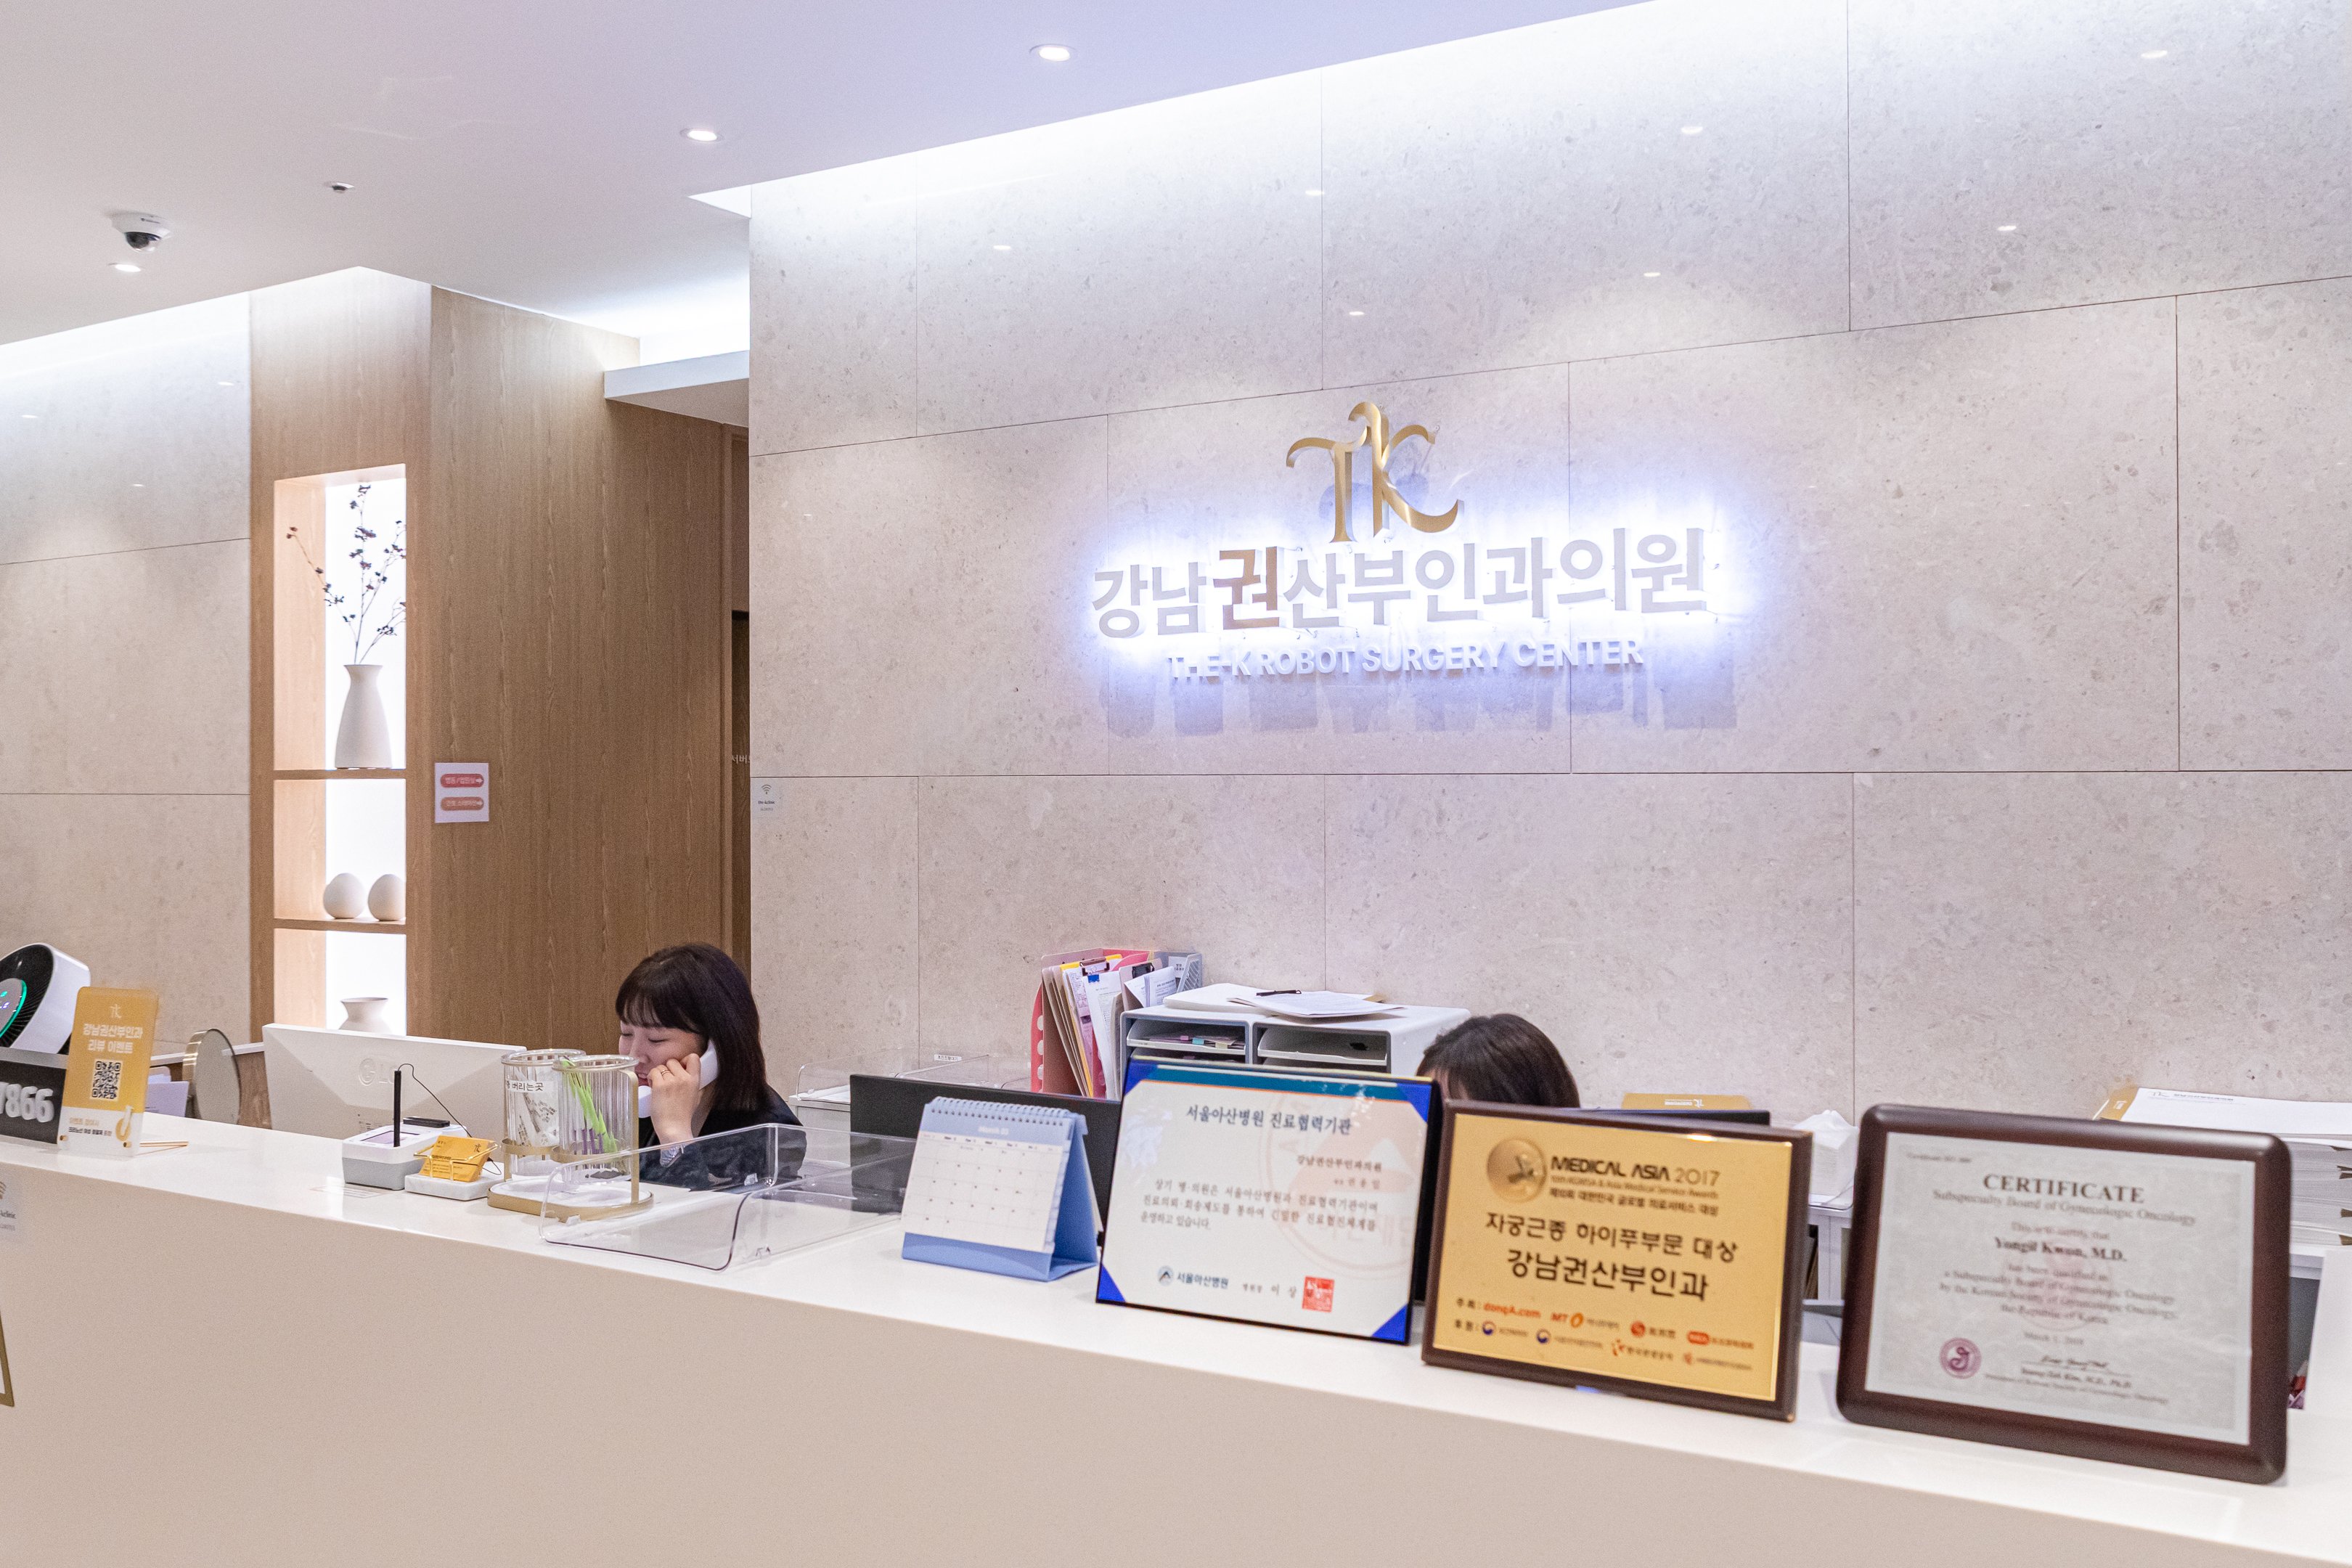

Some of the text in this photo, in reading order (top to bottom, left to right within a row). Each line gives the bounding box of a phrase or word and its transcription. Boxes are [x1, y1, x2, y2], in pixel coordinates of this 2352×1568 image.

[1092, 528, 1707, 639] 강남권산부인과의원
[1168, 637, 1644, 678] THE-K ROBOT SURGERY CENTER
[1186, 1104, 1352, 1135] 서울아산병원 진료협력기관
[1551, 1156, 1720, 1187] MEDICAL ASIA 2017
[1983, 1172, 2145, 1204] CERTIFICATE
[1485, 1212, 1738, 1264] 자궁근종 하이푸부문 대상
[2091, 1246, 2127, 1262] M.D.
[1177, 1271, 1229, 1289] 서울아산병원
[1507, 1248, 1710, 1302] 강남권산부인과
